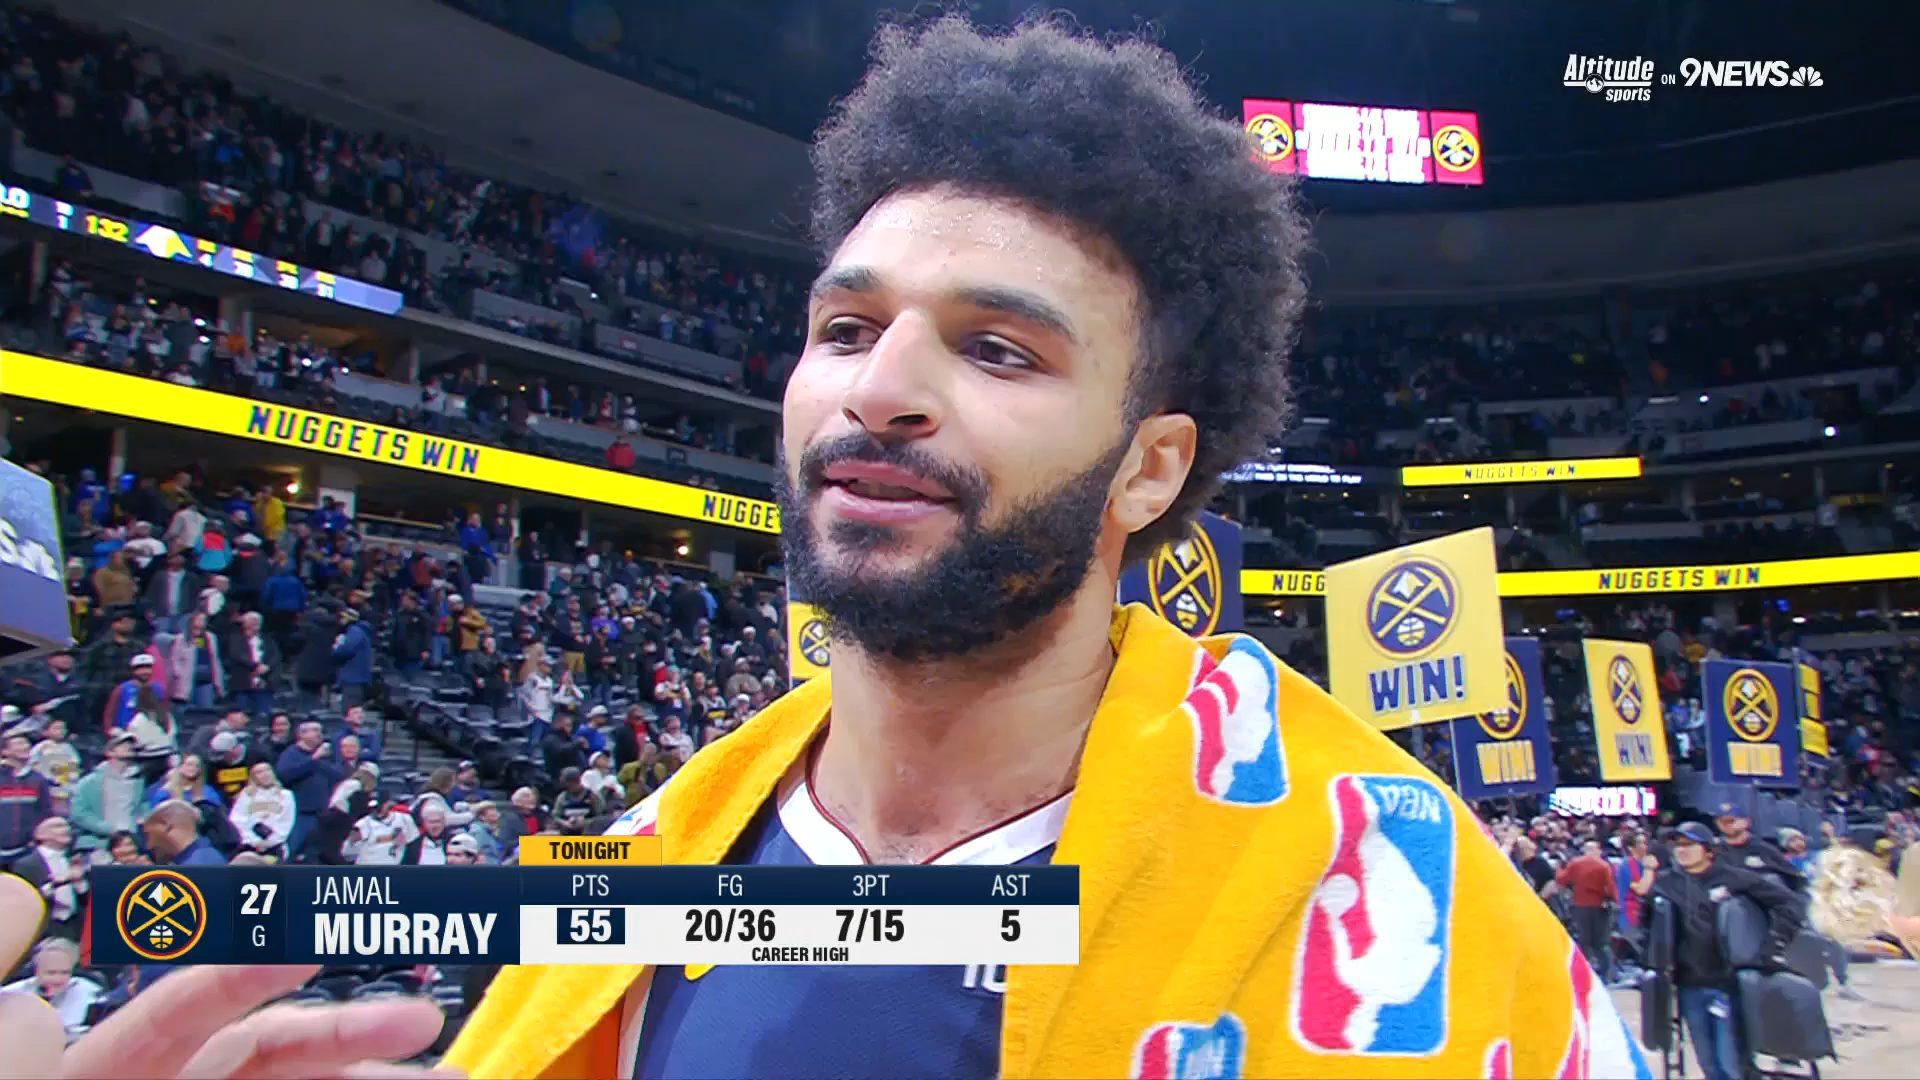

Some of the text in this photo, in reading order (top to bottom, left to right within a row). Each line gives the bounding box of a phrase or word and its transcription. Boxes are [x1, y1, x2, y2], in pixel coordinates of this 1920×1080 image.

[249, 405, 480, 474] NUGGETS WIN
[1598, 567, 1760, 590] NUGGETS WIN
[1369, 655, 1463, 712] WIN!
[1376, 784, 1441, 824] NBA
